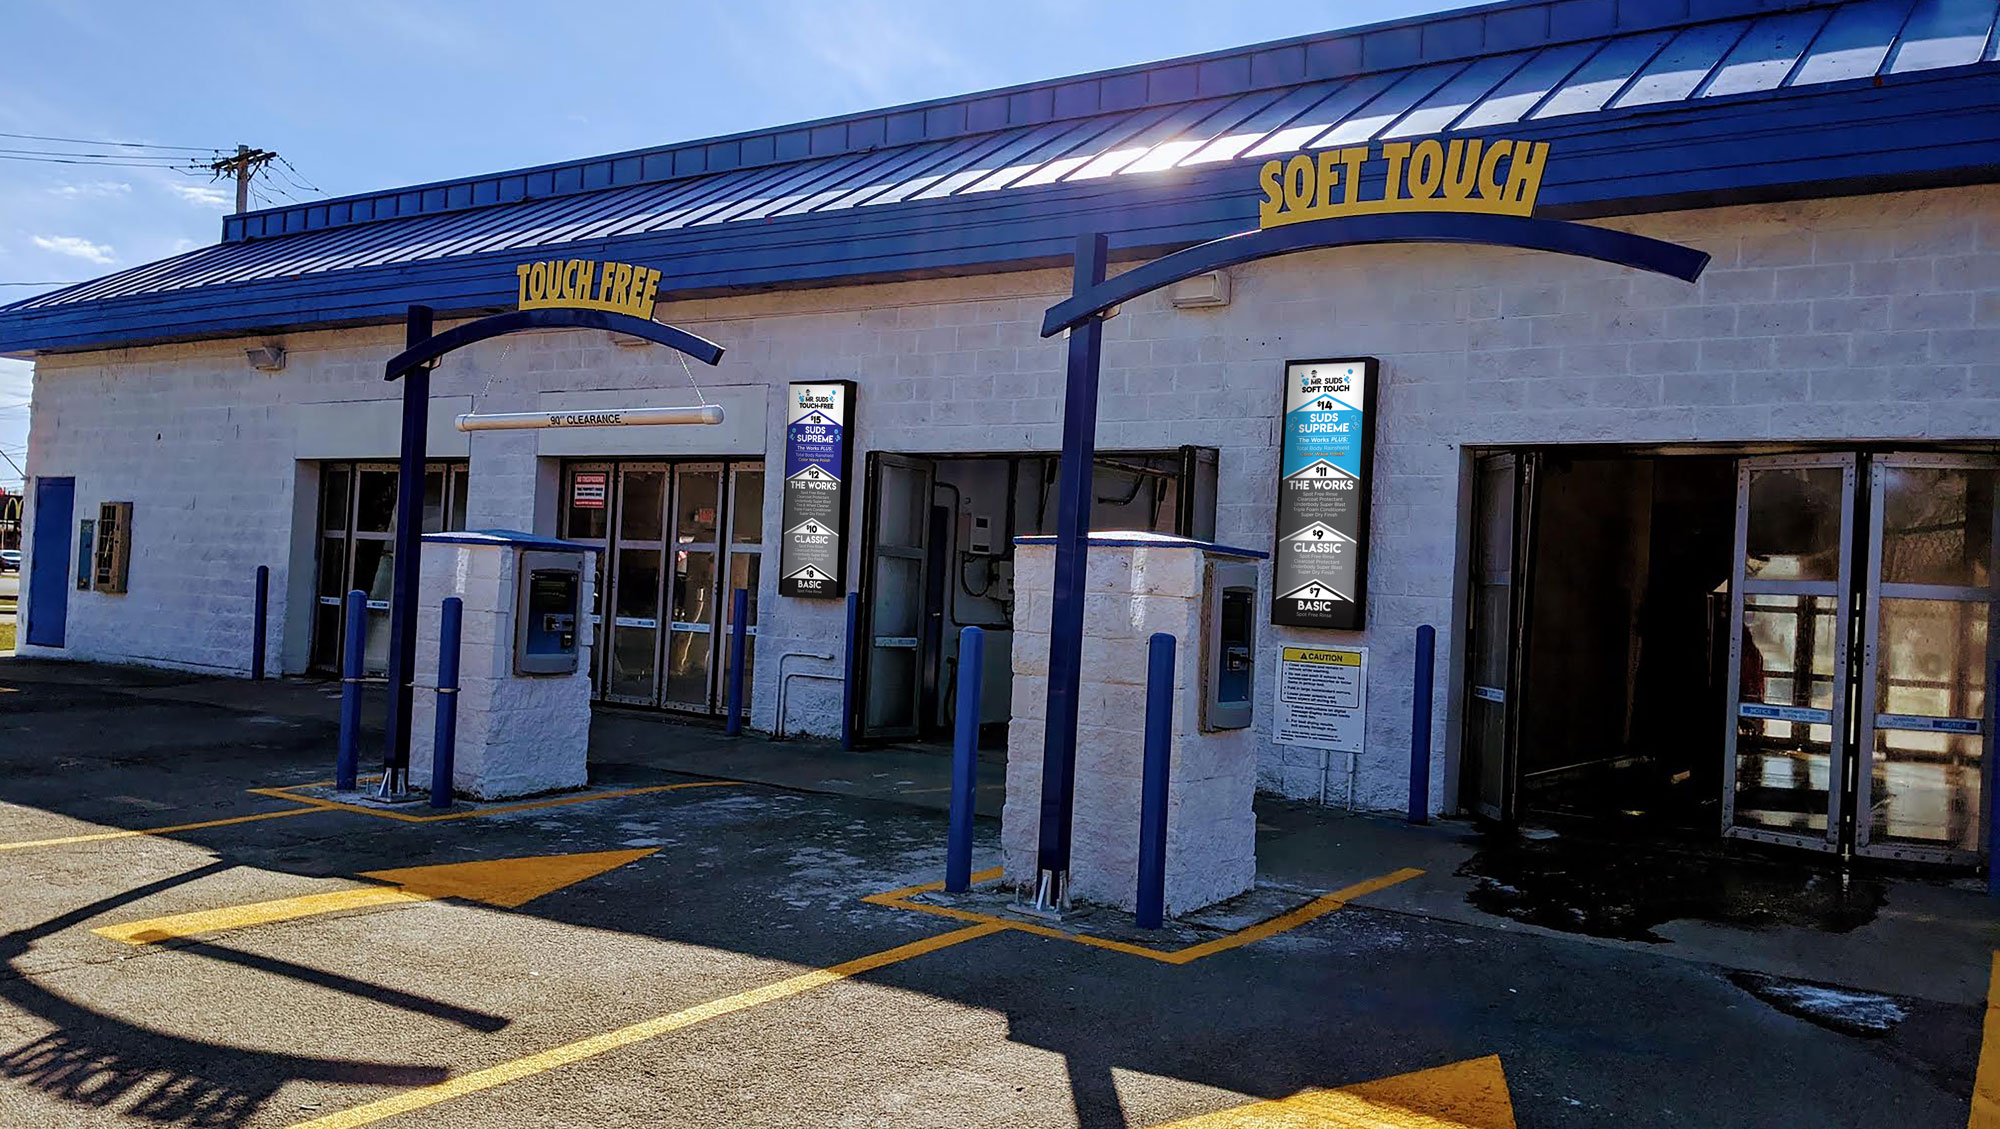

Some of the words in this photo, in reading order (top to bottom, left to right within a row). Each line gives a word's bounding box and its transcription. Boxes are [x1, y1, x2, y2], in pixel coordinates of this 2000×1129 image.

[1260, 146, 1369, 213] SOFT
[1382, 139, 1550, 206] TOUCH
[517, 259, 595, 304] TOUCH
[599, 261, 661, 312] FREE
[1323, 384, 1350, 392] TOUCH
[1317, 400, 1332, 410] $14
[566, 414, 621, 424] CLEARANCE
[1310, 413, 1338, 422] SUDS
[805, 426, 826, 434] SUDS
[1298, 423, 1349, 433] SUPREME
[797, 435, 833, 443] SUPREME
[809, 470, 819, 479] $12
[1316, 466, 1327, 476] $11
[791, 481, 806, 489] THE
[808, 481, 837, 490] WORKS
[1289, 480, 1309, 490] THE
[1313, 480, 1354, 490] WORKS
[806, 525, 817, 533] $10
[794, 535, 828, 544] CLASSIC
[1313, 530, 1324, 540] $9
[1294, 543, 1342, 553] CLASSIC
[806, 570, 814, 578] $8
[798, 580, 822, 589] BASIC
[1310, 587, 1320, 598] $7
[1298, 601, 1332, 612] BASIC
[1308, 653, 1343, 662] CAUTION
